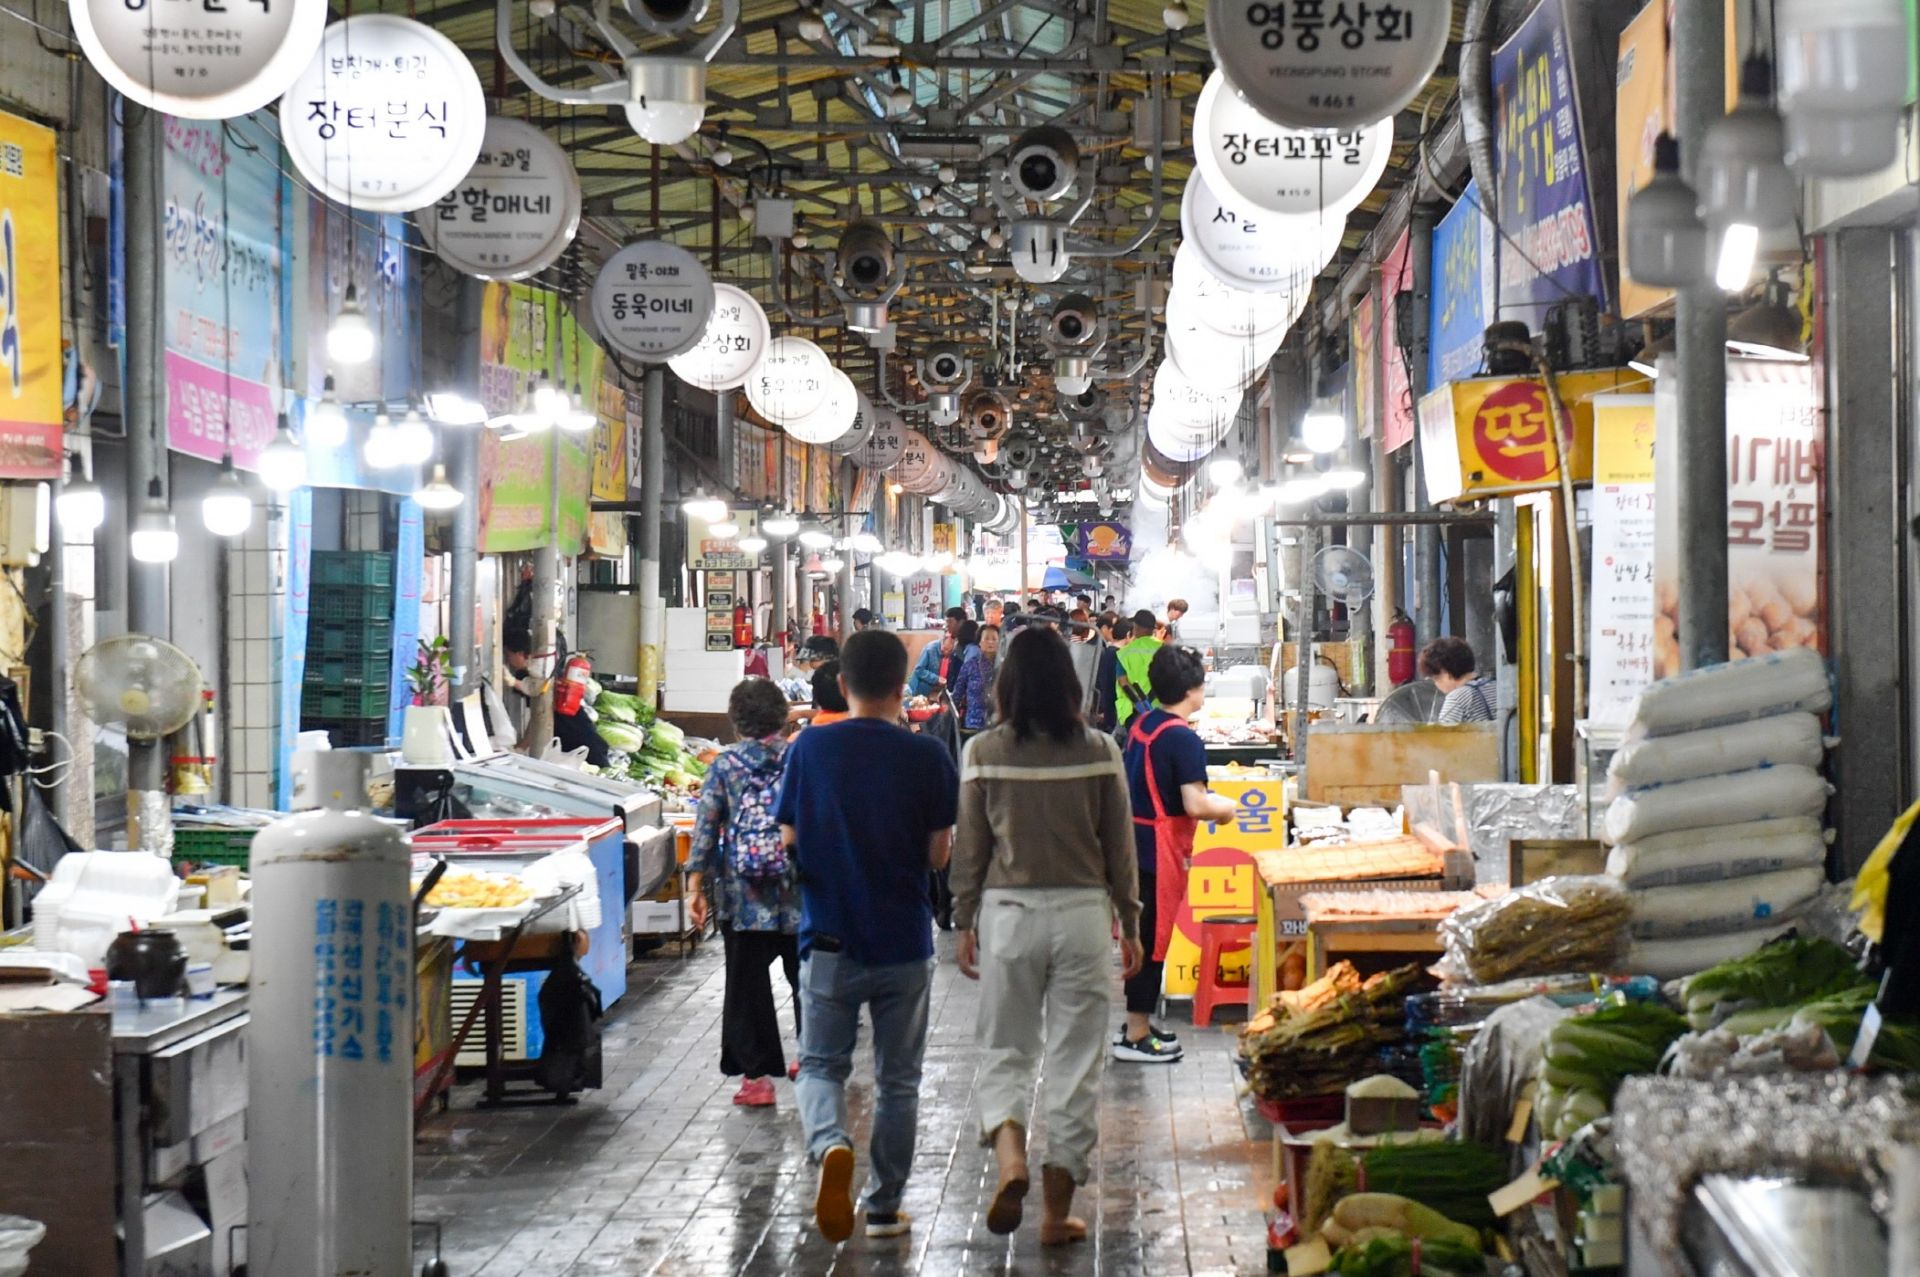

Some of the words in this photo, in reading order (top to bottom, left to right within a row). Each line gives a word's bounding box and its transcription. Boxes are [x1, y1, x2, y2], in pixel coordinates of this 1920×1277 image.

[1247, 0, 1412, 50] 영풍상회
[308, 100, 446, 139] 장터분식
[476, 148, 531, 172] 채·과일
[436, 187, 551, 222] 윤할매네
[611, 293, 693, 320] 동욱이네
[1479, 390, 1559, 475] 떡
